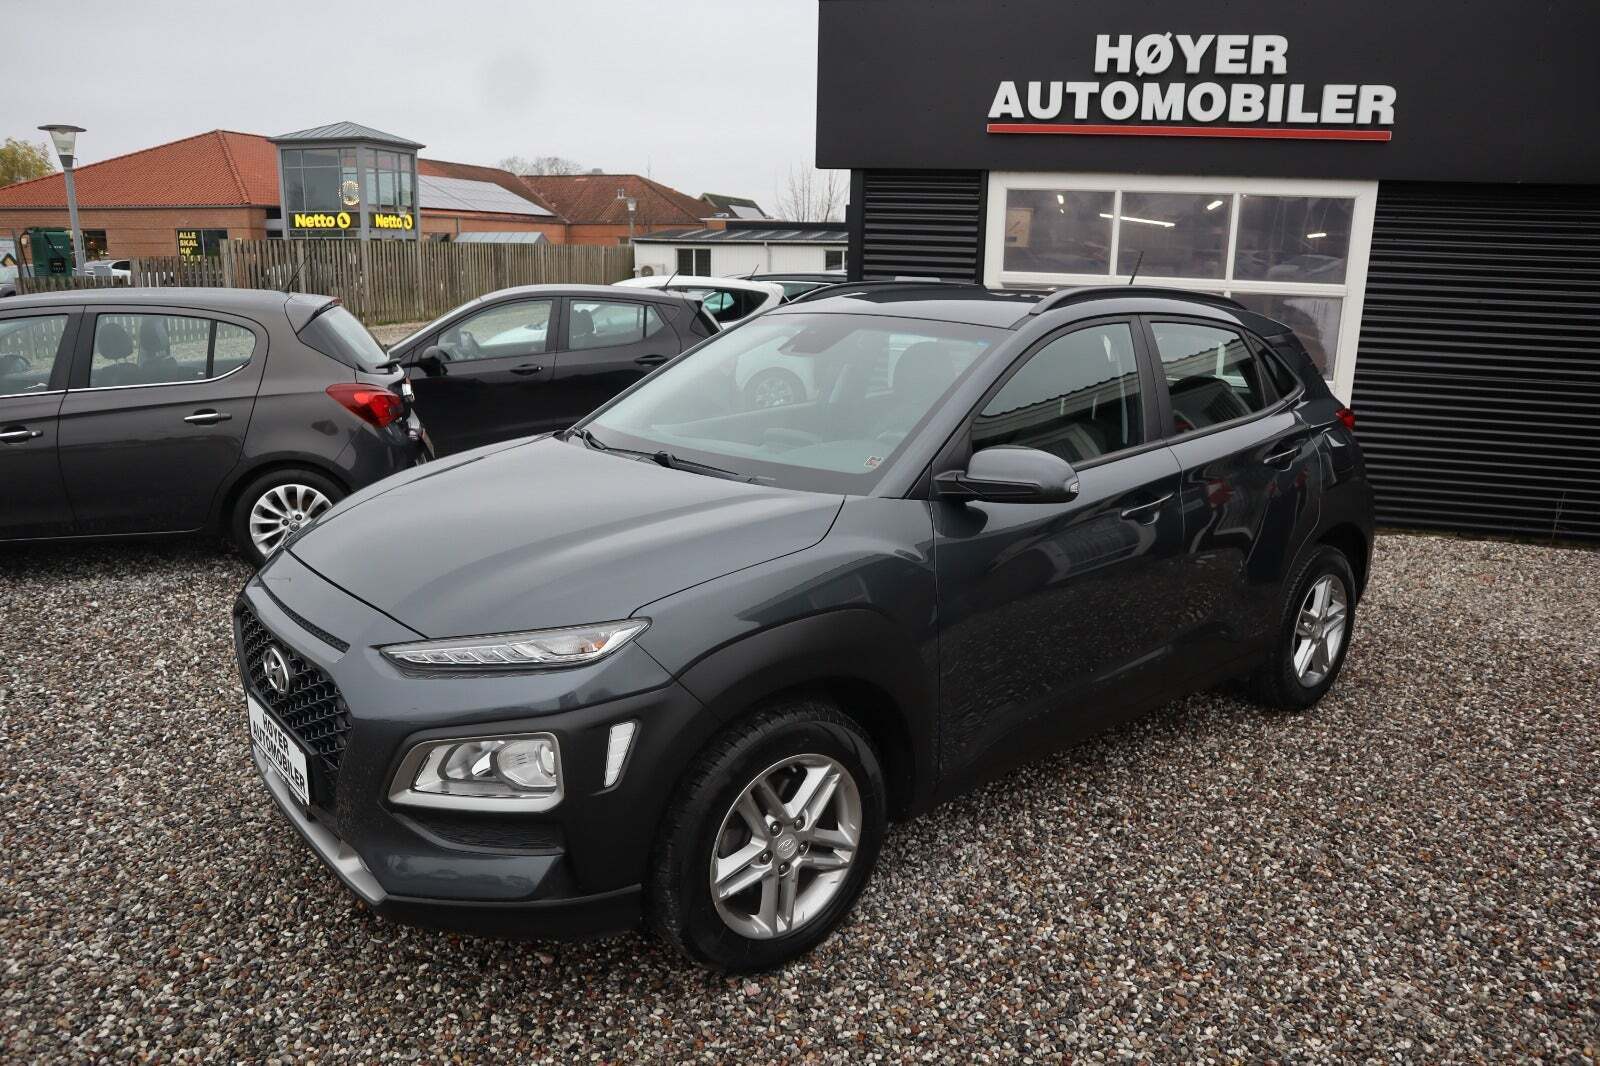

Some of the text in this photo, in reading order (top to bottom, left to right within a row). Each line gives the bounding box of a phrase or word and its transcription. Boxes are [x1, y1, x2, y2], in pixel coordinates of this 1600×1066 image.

[1094, 32, 1289, 77] HØYER
[988, 80, 1398, 124] AUTOMOBILER
[295, 213, 335, 228] Netto
[375, 213, 403, 228] Netto
[179, 239, 198, 247] SKAL
[262, 713, 289, 756] HØYER
[253, 720, 305, 793] AUTOMOBILER
